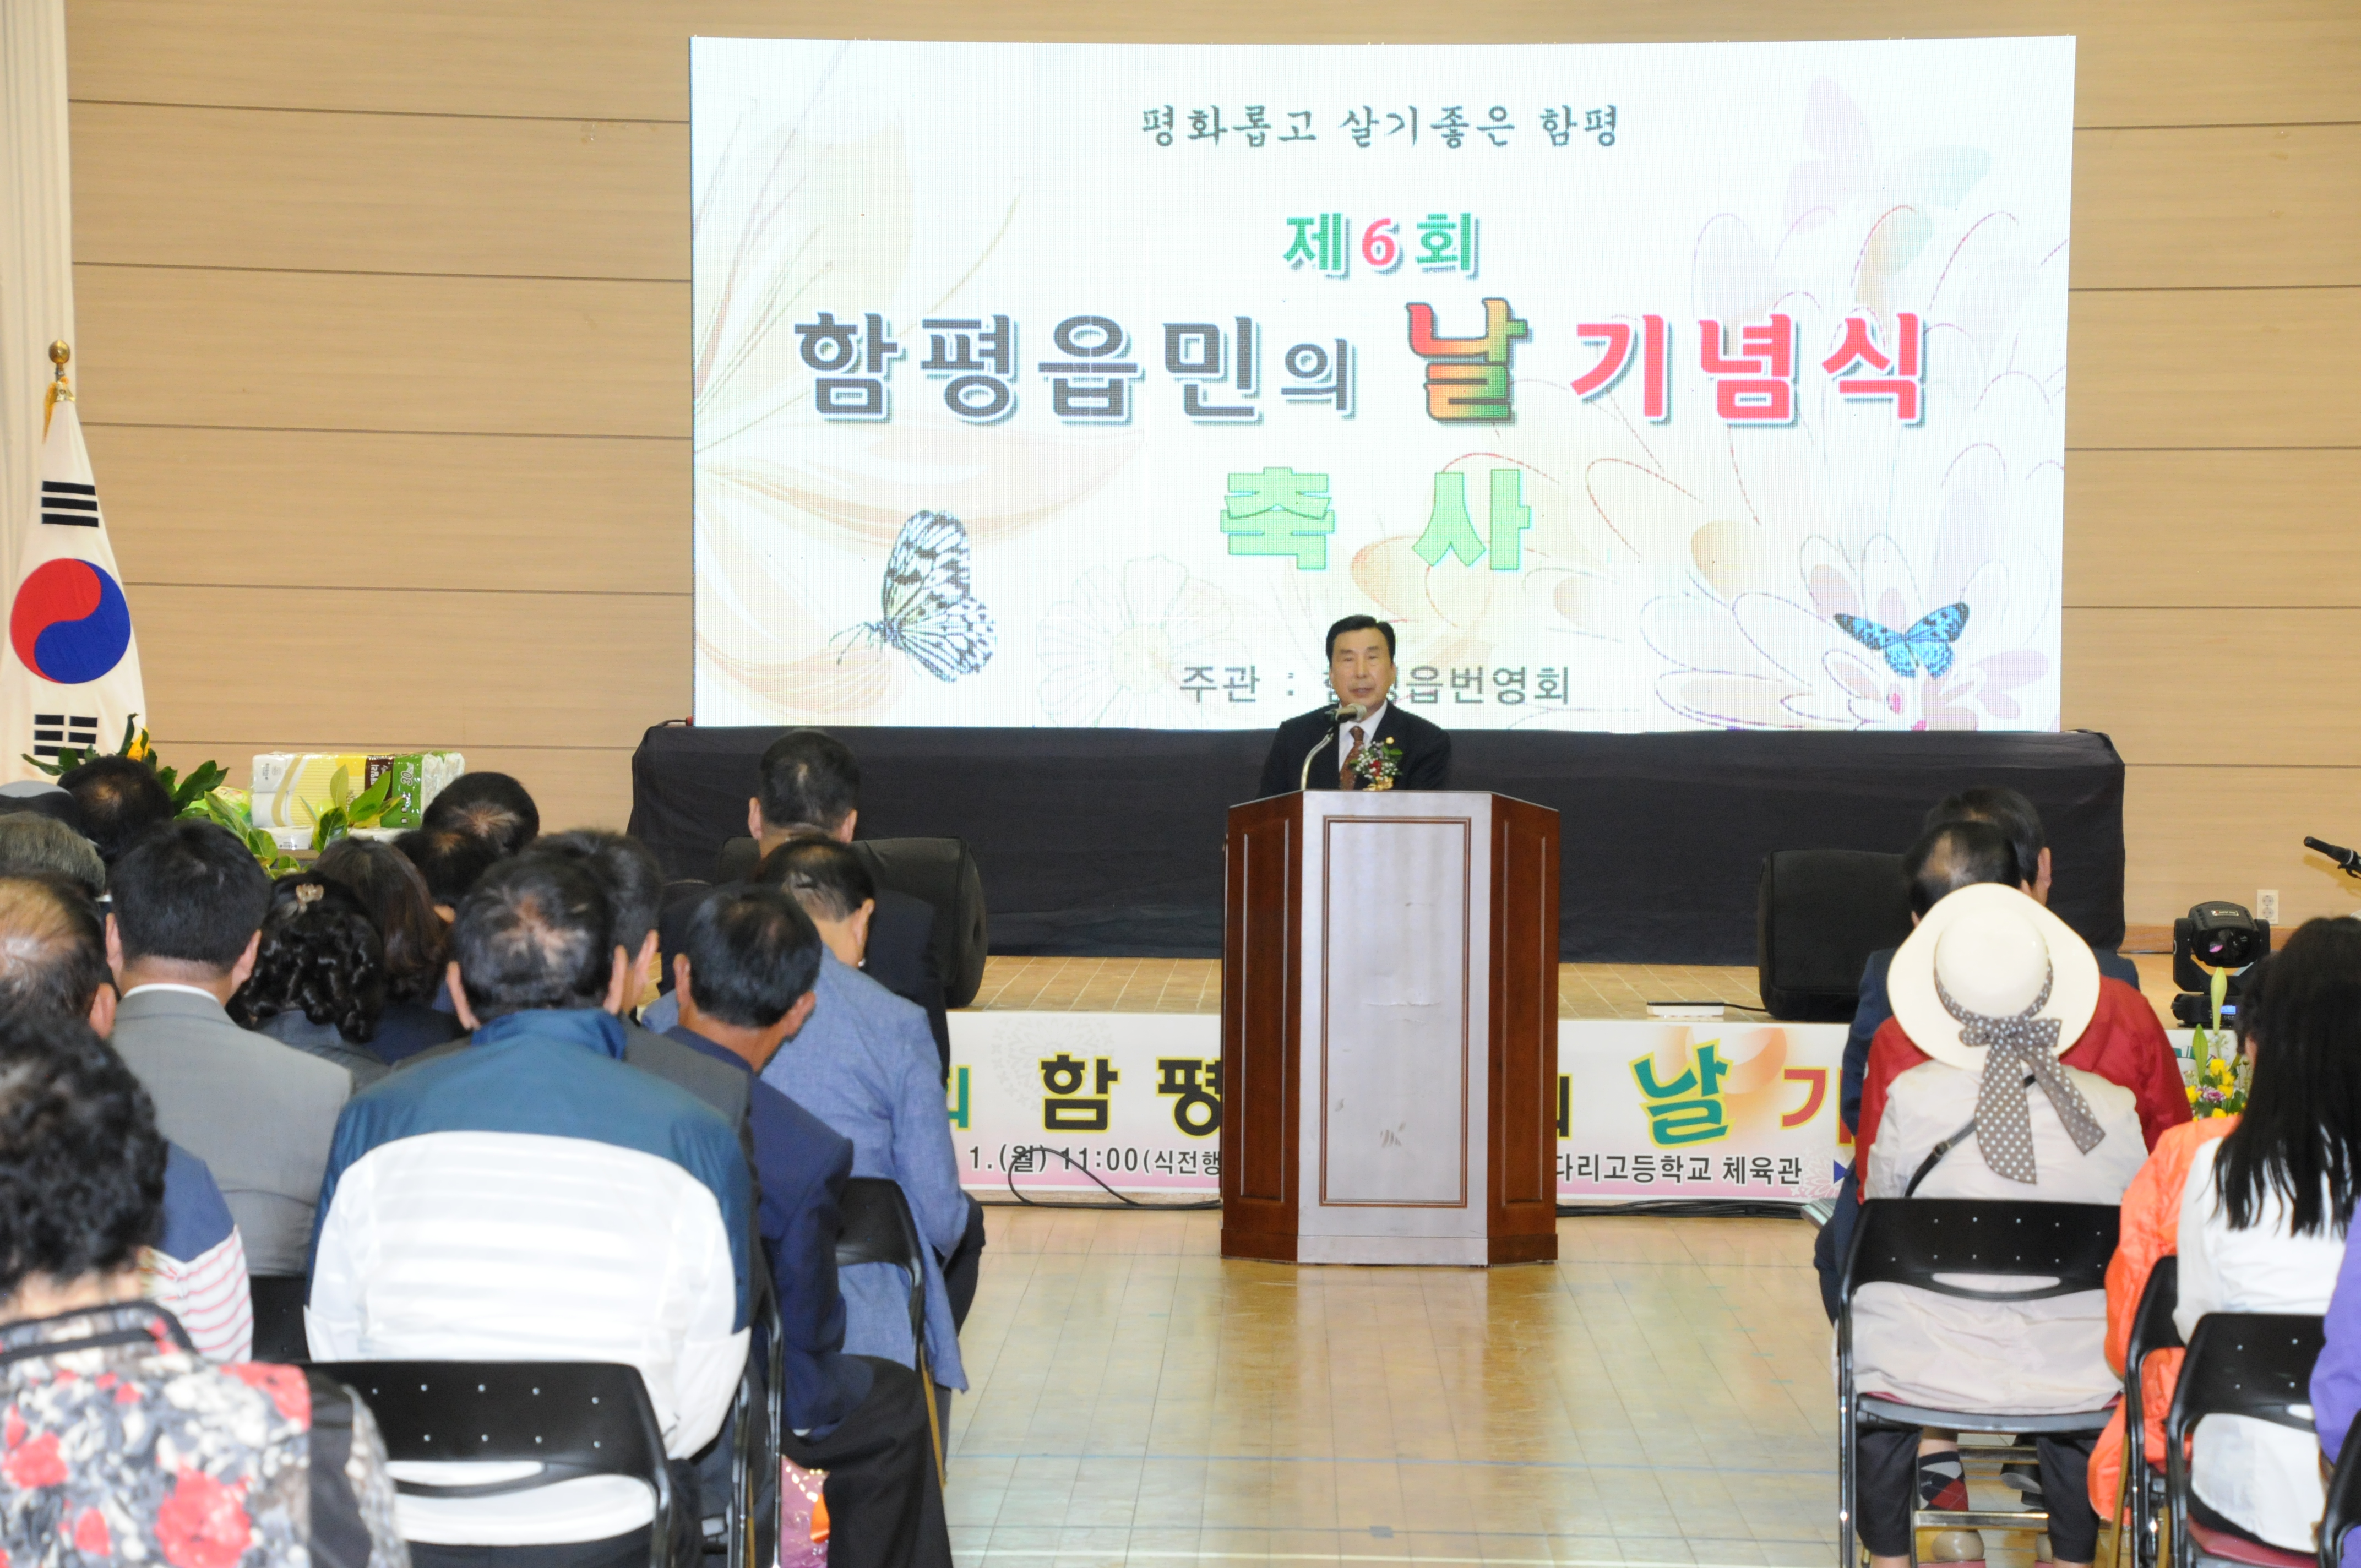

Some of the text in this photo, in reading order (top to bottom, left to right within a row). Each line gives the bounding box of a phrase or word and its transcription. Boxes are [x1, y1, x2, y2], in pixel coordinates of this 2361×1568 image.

[1142, 105, 1618, 149] 평화롭고 살기좋은 함평
[1283, 212, 1477, 276] 제6회
[794, 297, 1922, 424] 함평읍민의 날 기념식
[1179, 665, 1261, 704] 주관
[1323, 665, 1569, 705] 읍번영회
[1630, 1039, 1733, 1149] 날
[1723, 1156, 1803, 1185] 체육관
